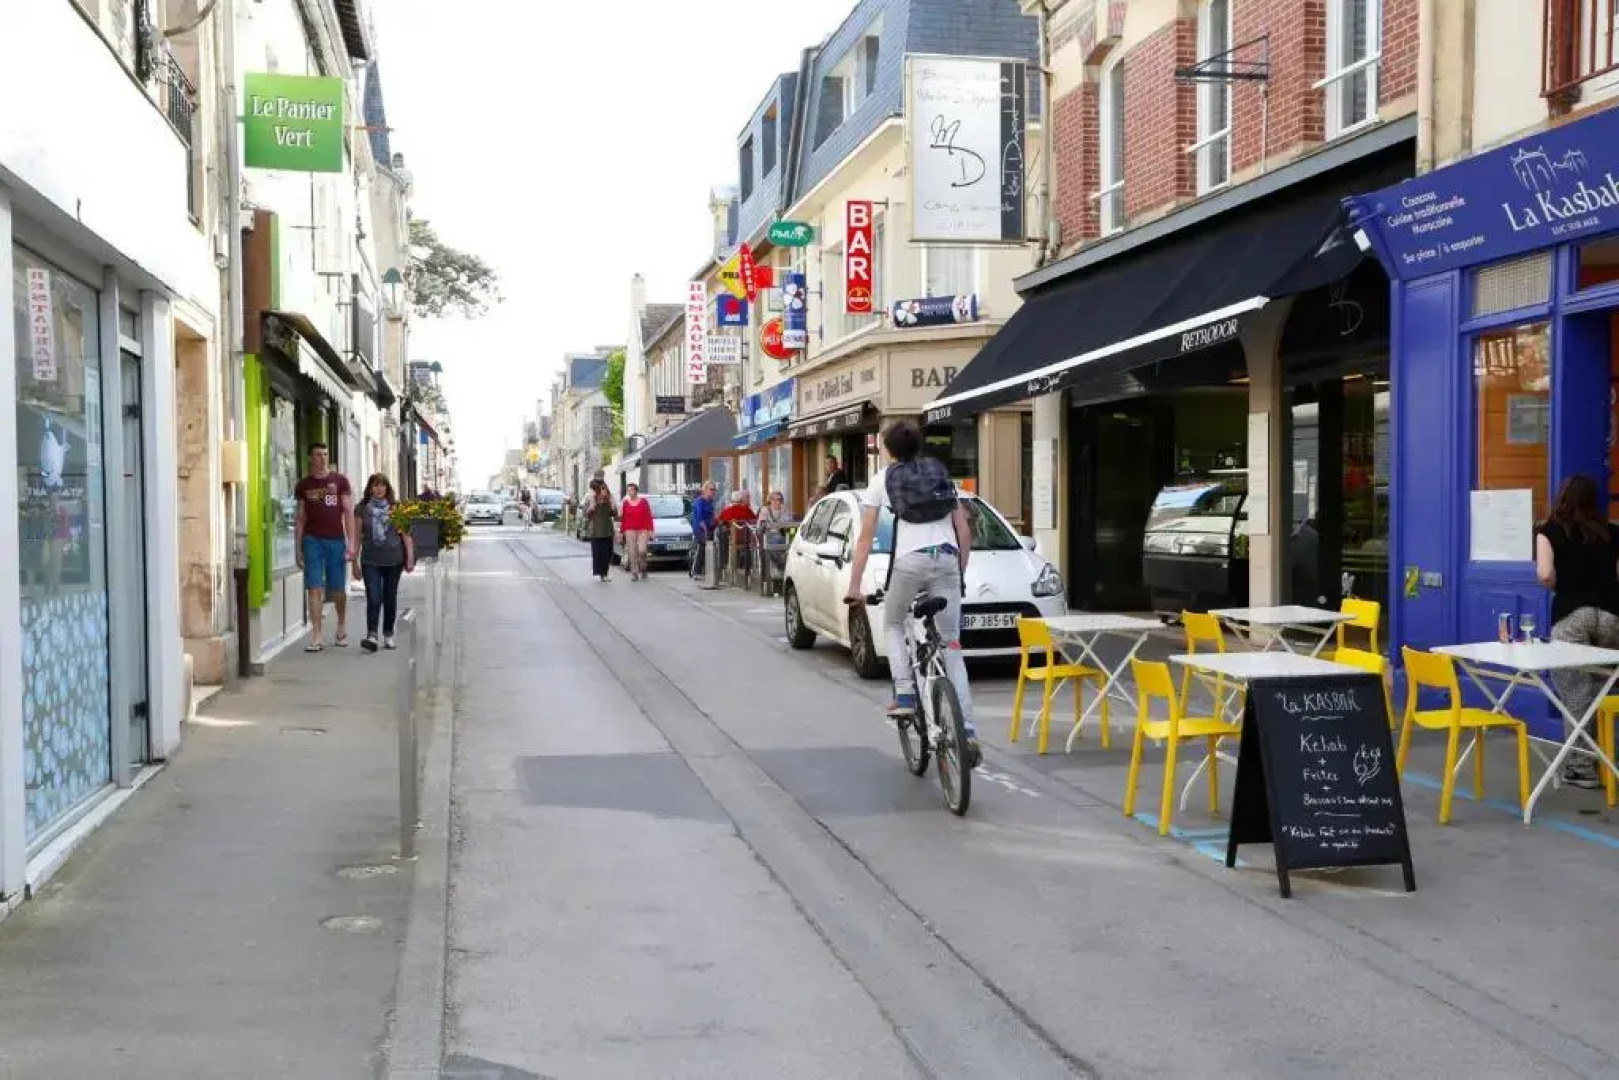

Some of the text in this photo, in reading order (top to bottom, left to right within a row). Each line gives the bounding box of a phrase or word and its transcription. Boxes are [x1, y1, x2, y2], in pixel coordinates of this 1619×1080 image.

[252, 95, 336, 121] Le Panier
[274, 125, 315, 148] Vert
[1501, 202, 1536, 231] La
[849, 203, 870, 281] BAR
[688, 283, 705, 381] RESTAURANT
[325, 494, 338, 507] 88
[1300, 733, 1348, 753] Kebab
